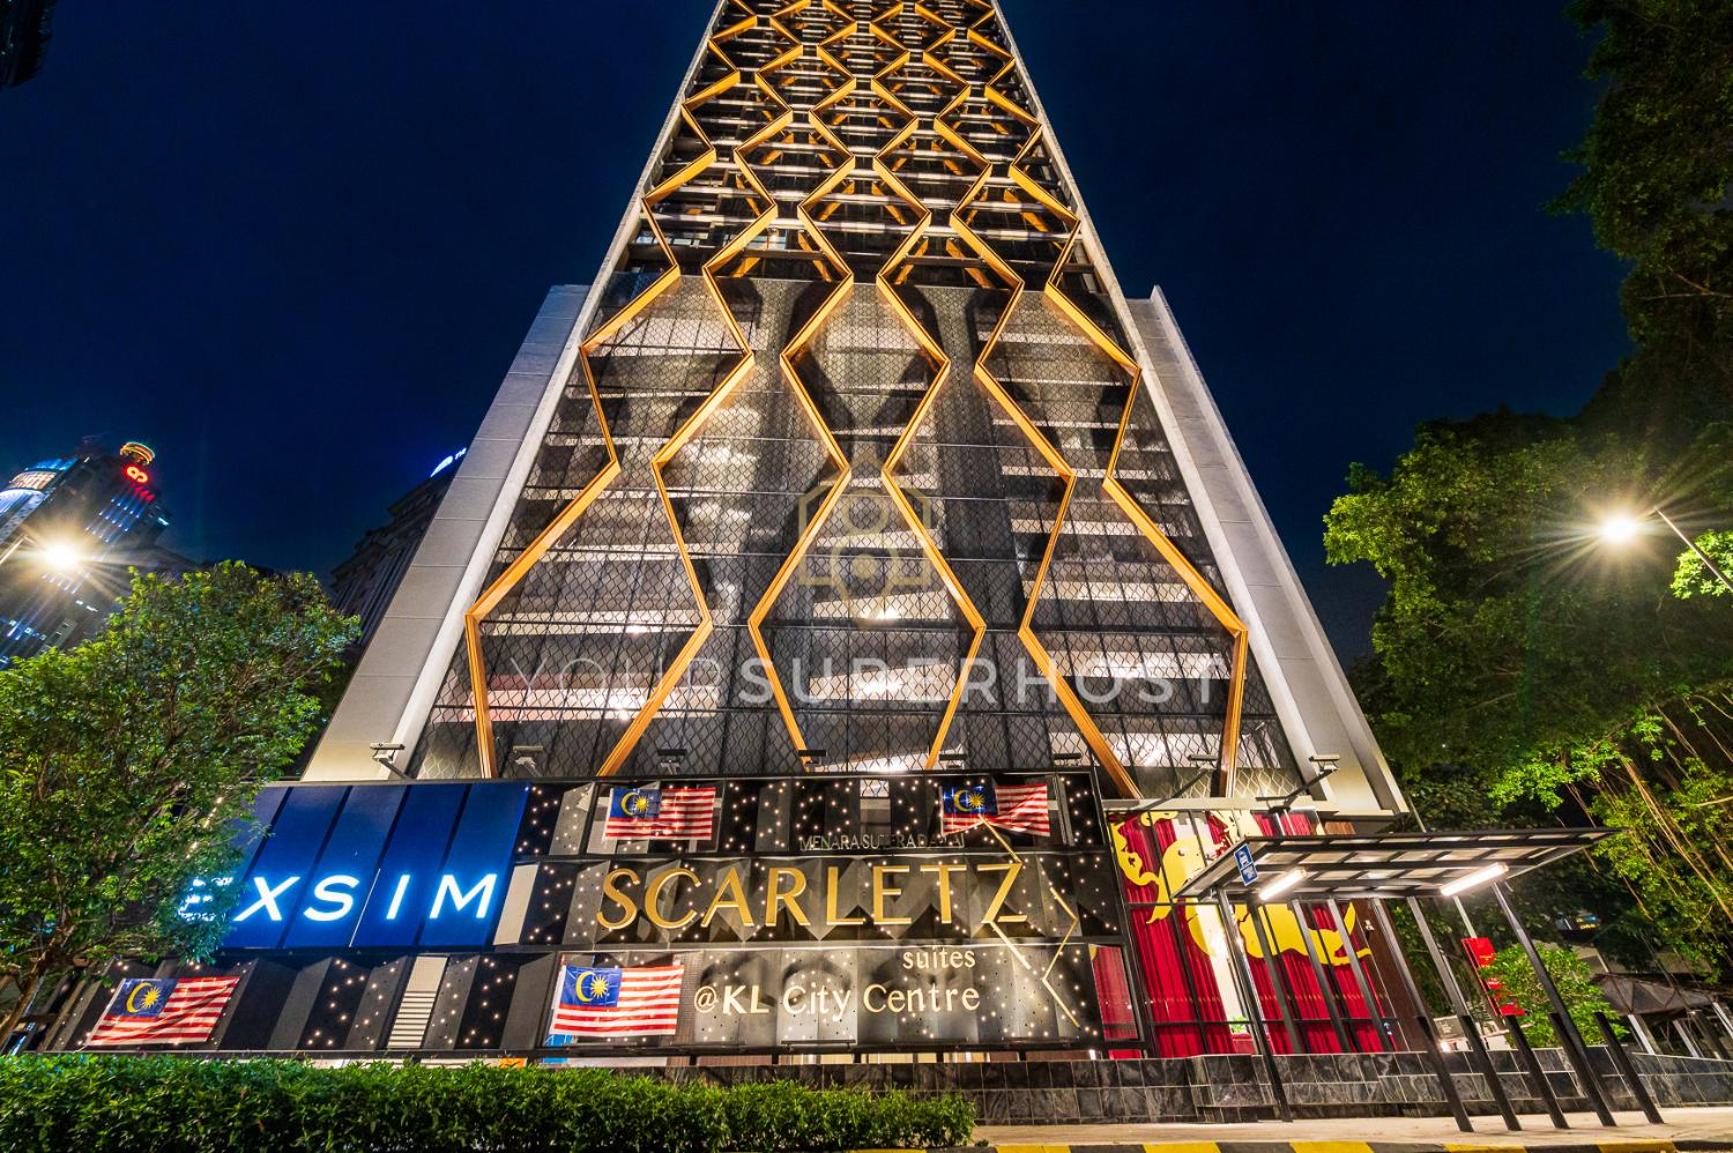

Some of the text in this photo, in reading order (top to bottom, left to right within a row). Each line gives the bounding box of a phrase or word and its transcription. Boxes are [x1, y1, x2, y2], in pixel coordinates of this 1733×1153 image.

[800, 833, 859, 850] MENARA
[178, 873, 497, 922] EXSIM
[596, 863, 1028, 929] SCARLETZ
[902, 946, 977, 970] suites
[694, 983, 981, 1022] @KL City Centre
